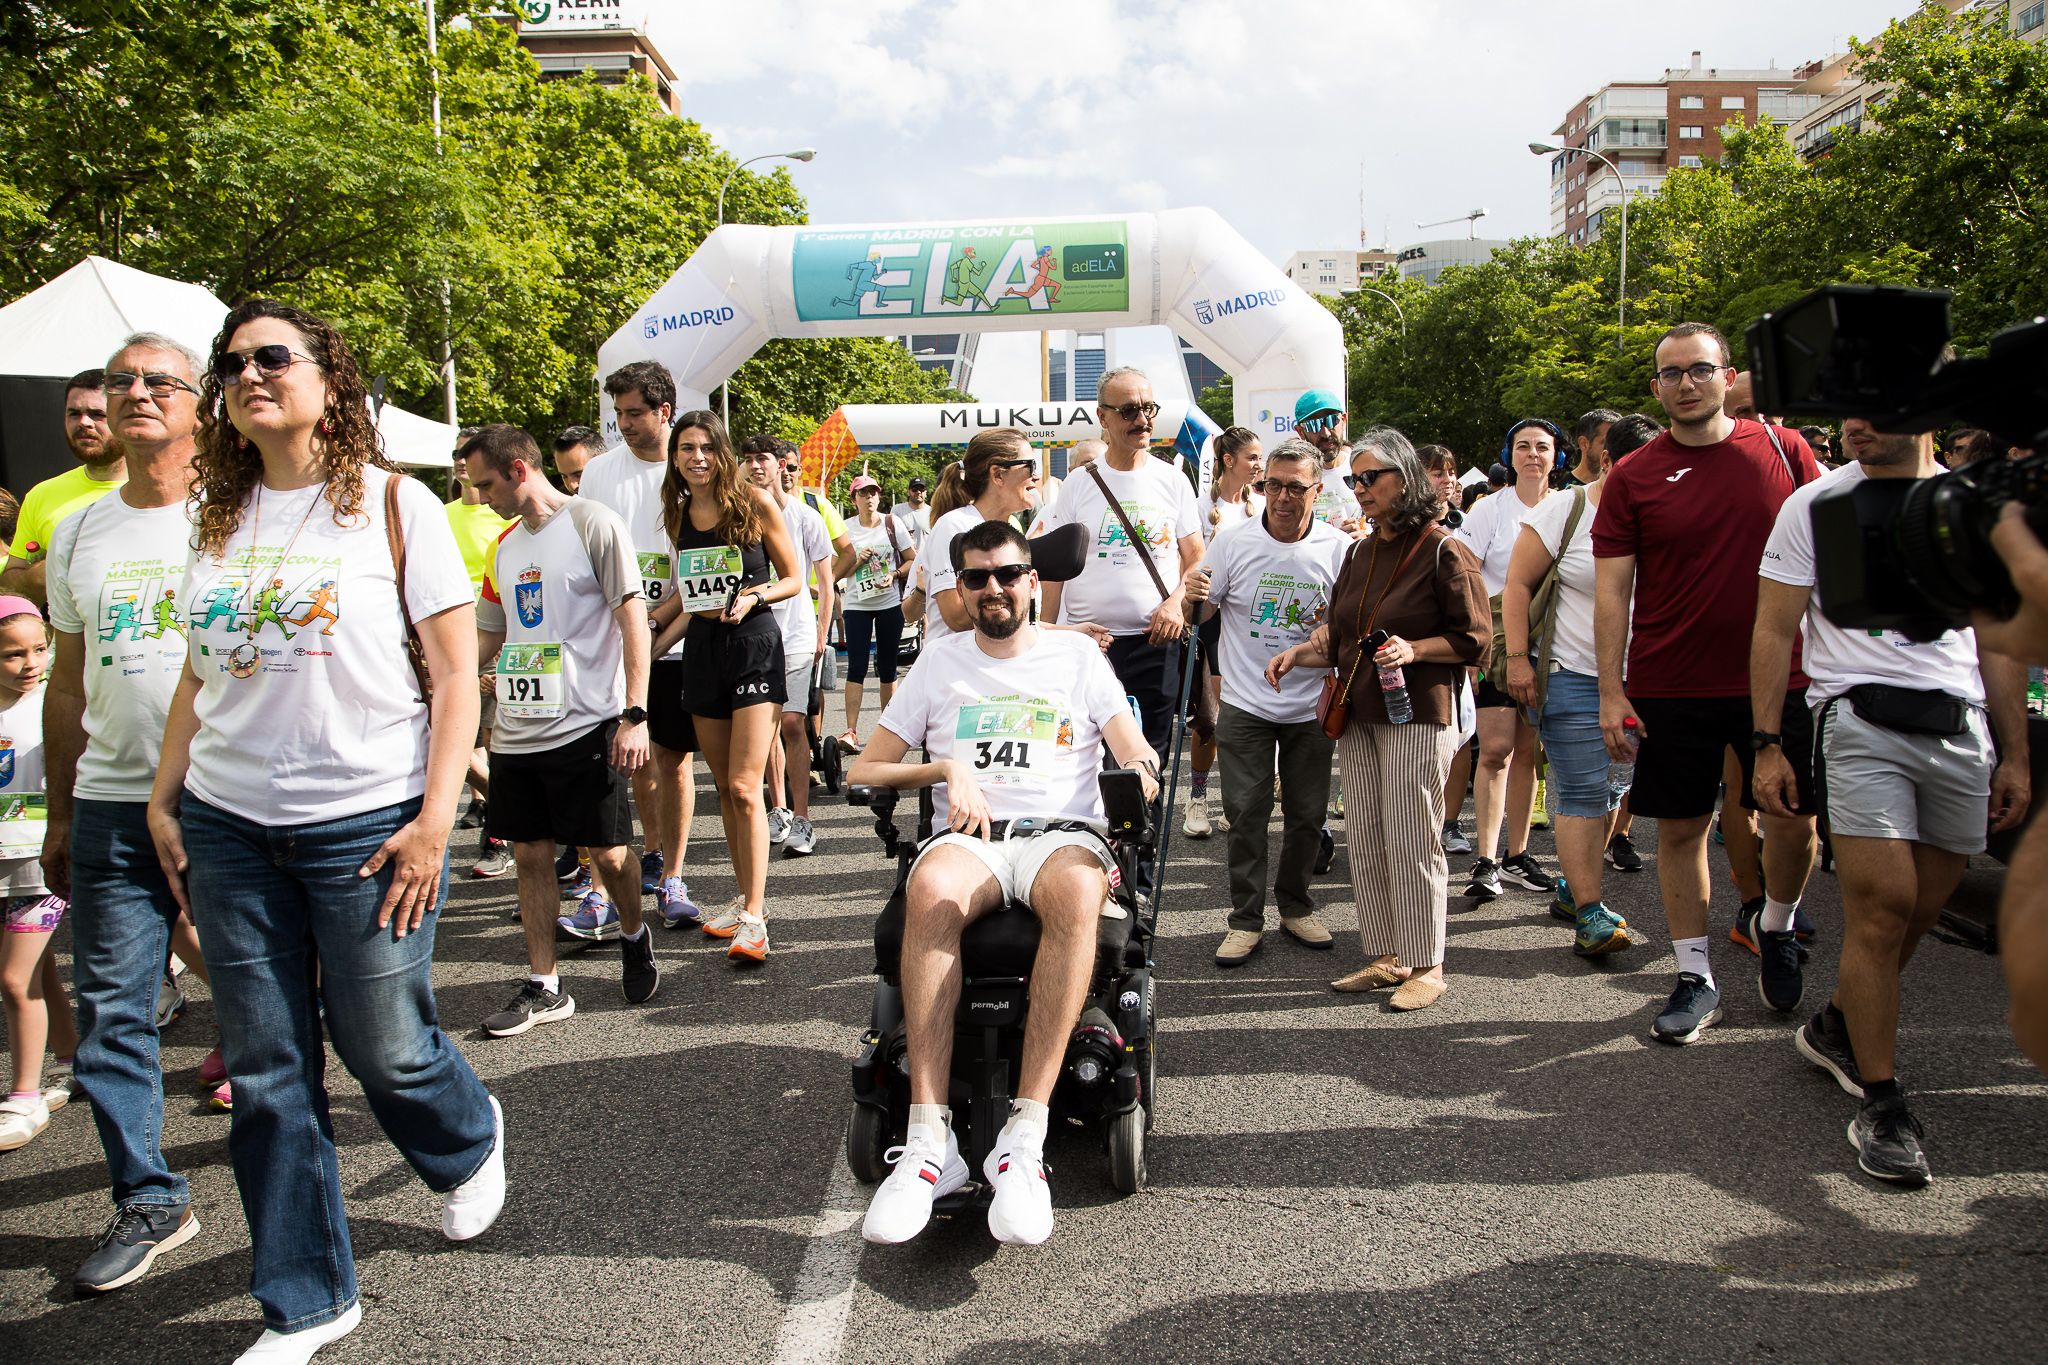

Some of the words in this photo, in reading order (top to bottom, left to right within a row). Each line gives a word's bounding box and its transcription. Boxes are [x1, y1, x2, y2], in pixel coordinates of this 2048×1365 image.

[871, 228, 954, 241] MADRID
[959, 226, 1004, 238] CON
[1008, 225, 1035, 236] LA
[858, 238, 1052, 317] ELA
[1216, 289, 1286, 317] MADRID
[663, 306, 734, 332] MADRID
[940, 407, 1094, 428] MUKUA
[1026, 430, 1056, 438] LOURS
[105, 567, 165, 580] MADRID
[167, 565, 186, 574] CO
[690, 553, 728, 574] ELA
[684, 574, 740, 599] 1449
[1258, 579, 1295, 588] MADRID
[1296, 582, 1316, 590] CON
[1270, 572, 1294, 580] Carrera
[508, 677, 544, 702] 191
[990, 695, 1020, 703] Carrera
[975, 711, 1035, 735] ELA
[974, 741, 1031, 770] 341
[971, 1001, 1010, 1010] permobil
